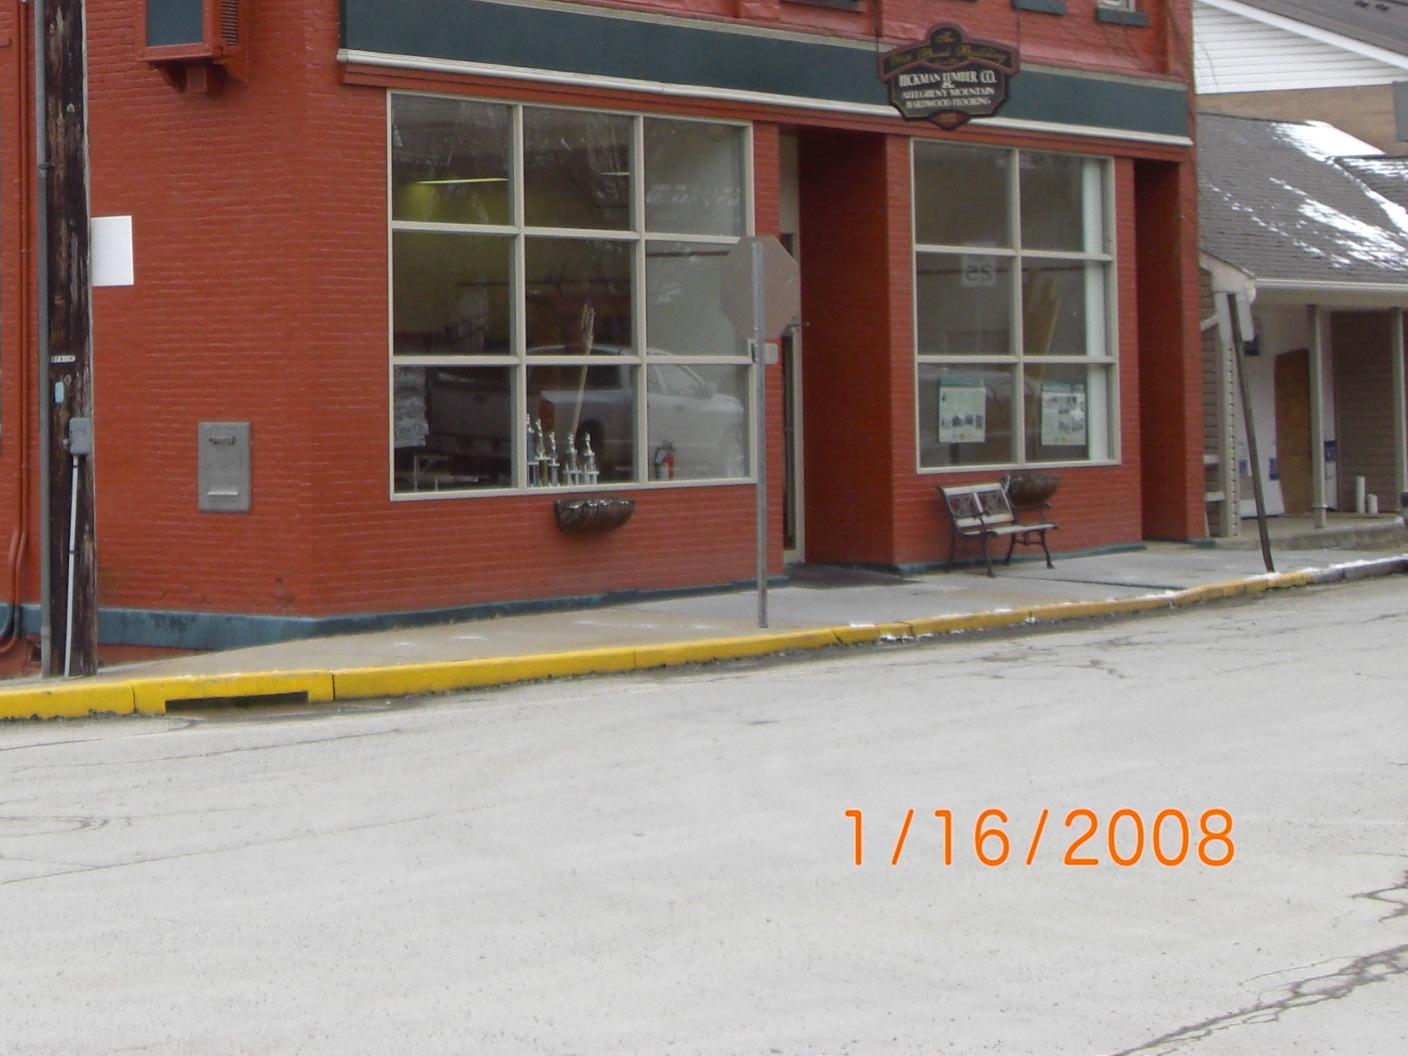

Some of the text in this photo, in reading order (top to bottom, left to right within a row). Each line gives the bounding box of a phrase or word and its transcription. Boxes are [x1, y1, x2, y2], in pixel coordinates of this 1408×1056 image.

[899, 70, 997, 88] HICKMAN LUMBER CO.
[942, 80, 955, 89] &
[902, 87, 995, 100] ALLEGHENY MOUNTAIN
[906, 97, 992, 109] HARDWOOD FLOORING
